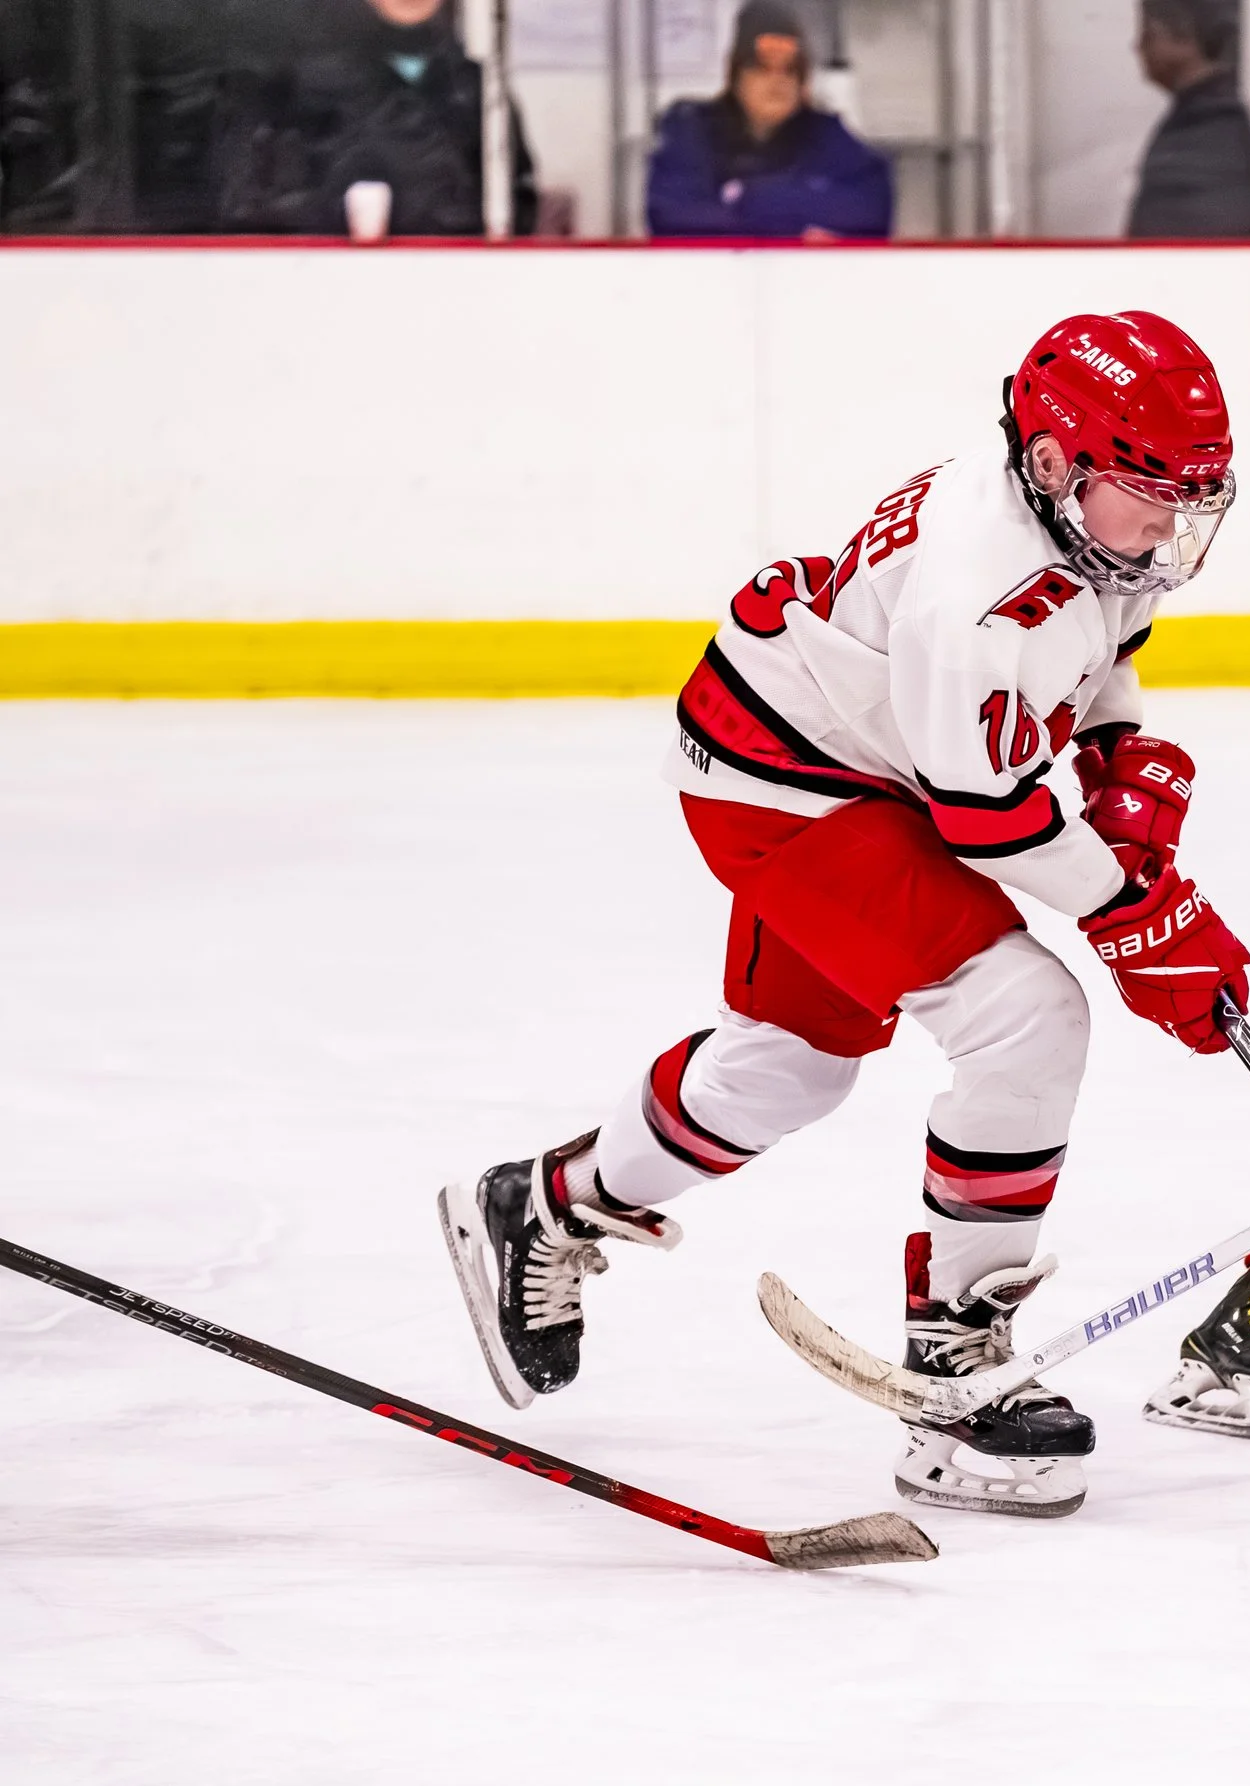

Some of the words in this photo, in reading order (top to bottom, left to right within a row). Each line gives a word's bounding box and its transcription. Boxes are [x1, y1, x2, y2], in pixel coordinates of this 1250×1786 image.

[1071, 337, 1137, 386] CANES
[1040, 393, 1077, 429] CCM
[1180, 462, 1225, 476] CCM
[680, 728, 711, 775] TEAM
[1097, 889, 1209, 961] BAUER
[109, 1287, 225, 1336] JETSPEED
[1083, 1252, 1218, 1345] BAUER
